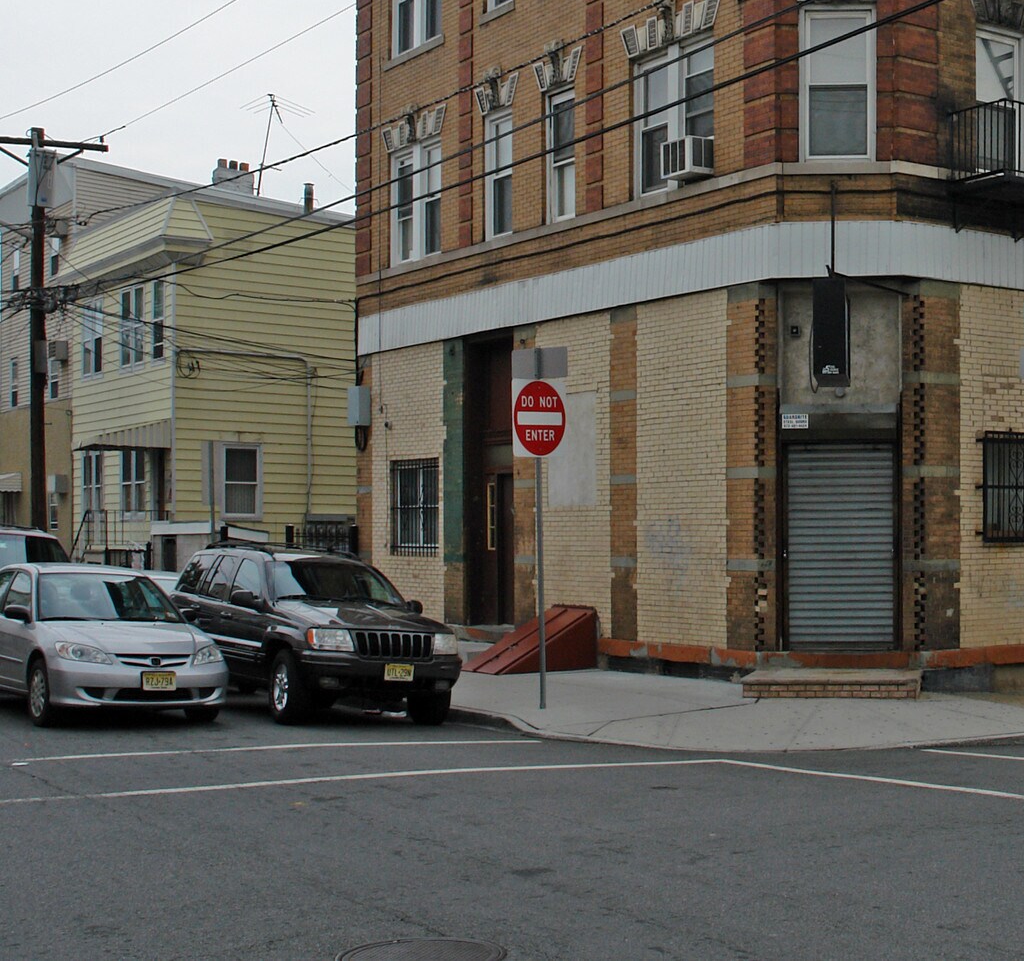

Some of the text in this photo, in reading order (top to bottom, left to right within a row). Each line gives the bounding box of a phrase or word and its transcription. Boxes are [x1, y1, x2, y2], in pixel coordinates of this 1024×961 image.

[521, 395, 558, 408] DO NOT
[525, 429, 555, 442] ENTER
